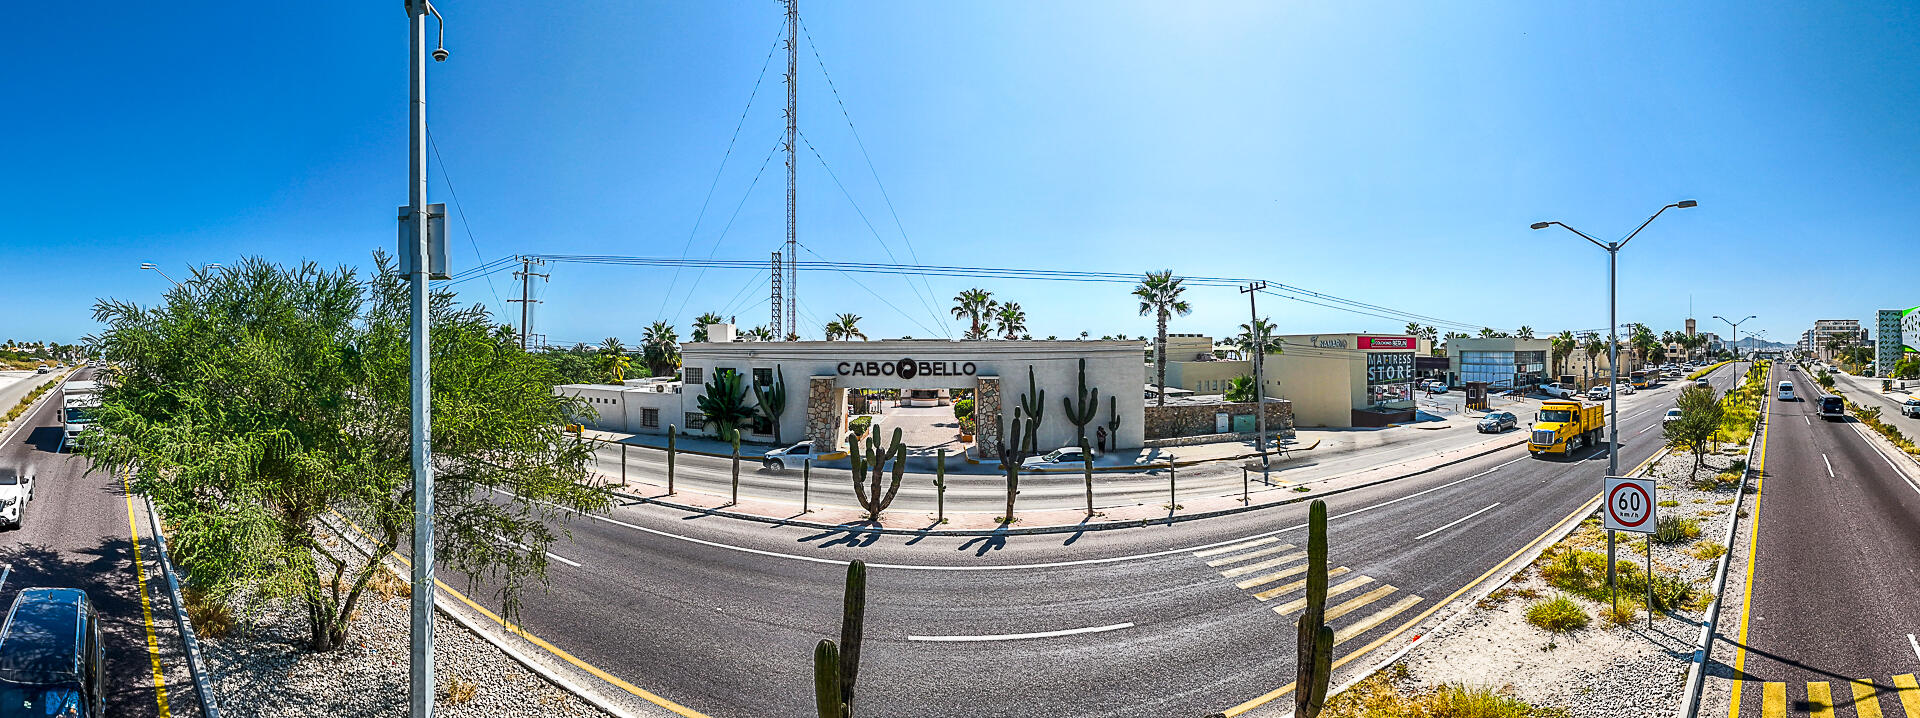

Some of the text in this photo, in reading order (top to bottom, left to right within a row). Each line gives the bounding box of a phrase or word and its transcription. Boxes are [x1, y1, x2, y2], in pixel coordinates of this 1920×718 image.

[1368, 354, 1412, 365] MATTRESS
[837, 361, 977, 376] CABO BELLO
[1368, 365, 1412, 381] STORE
[1618, 491, 1640, 512] 60
